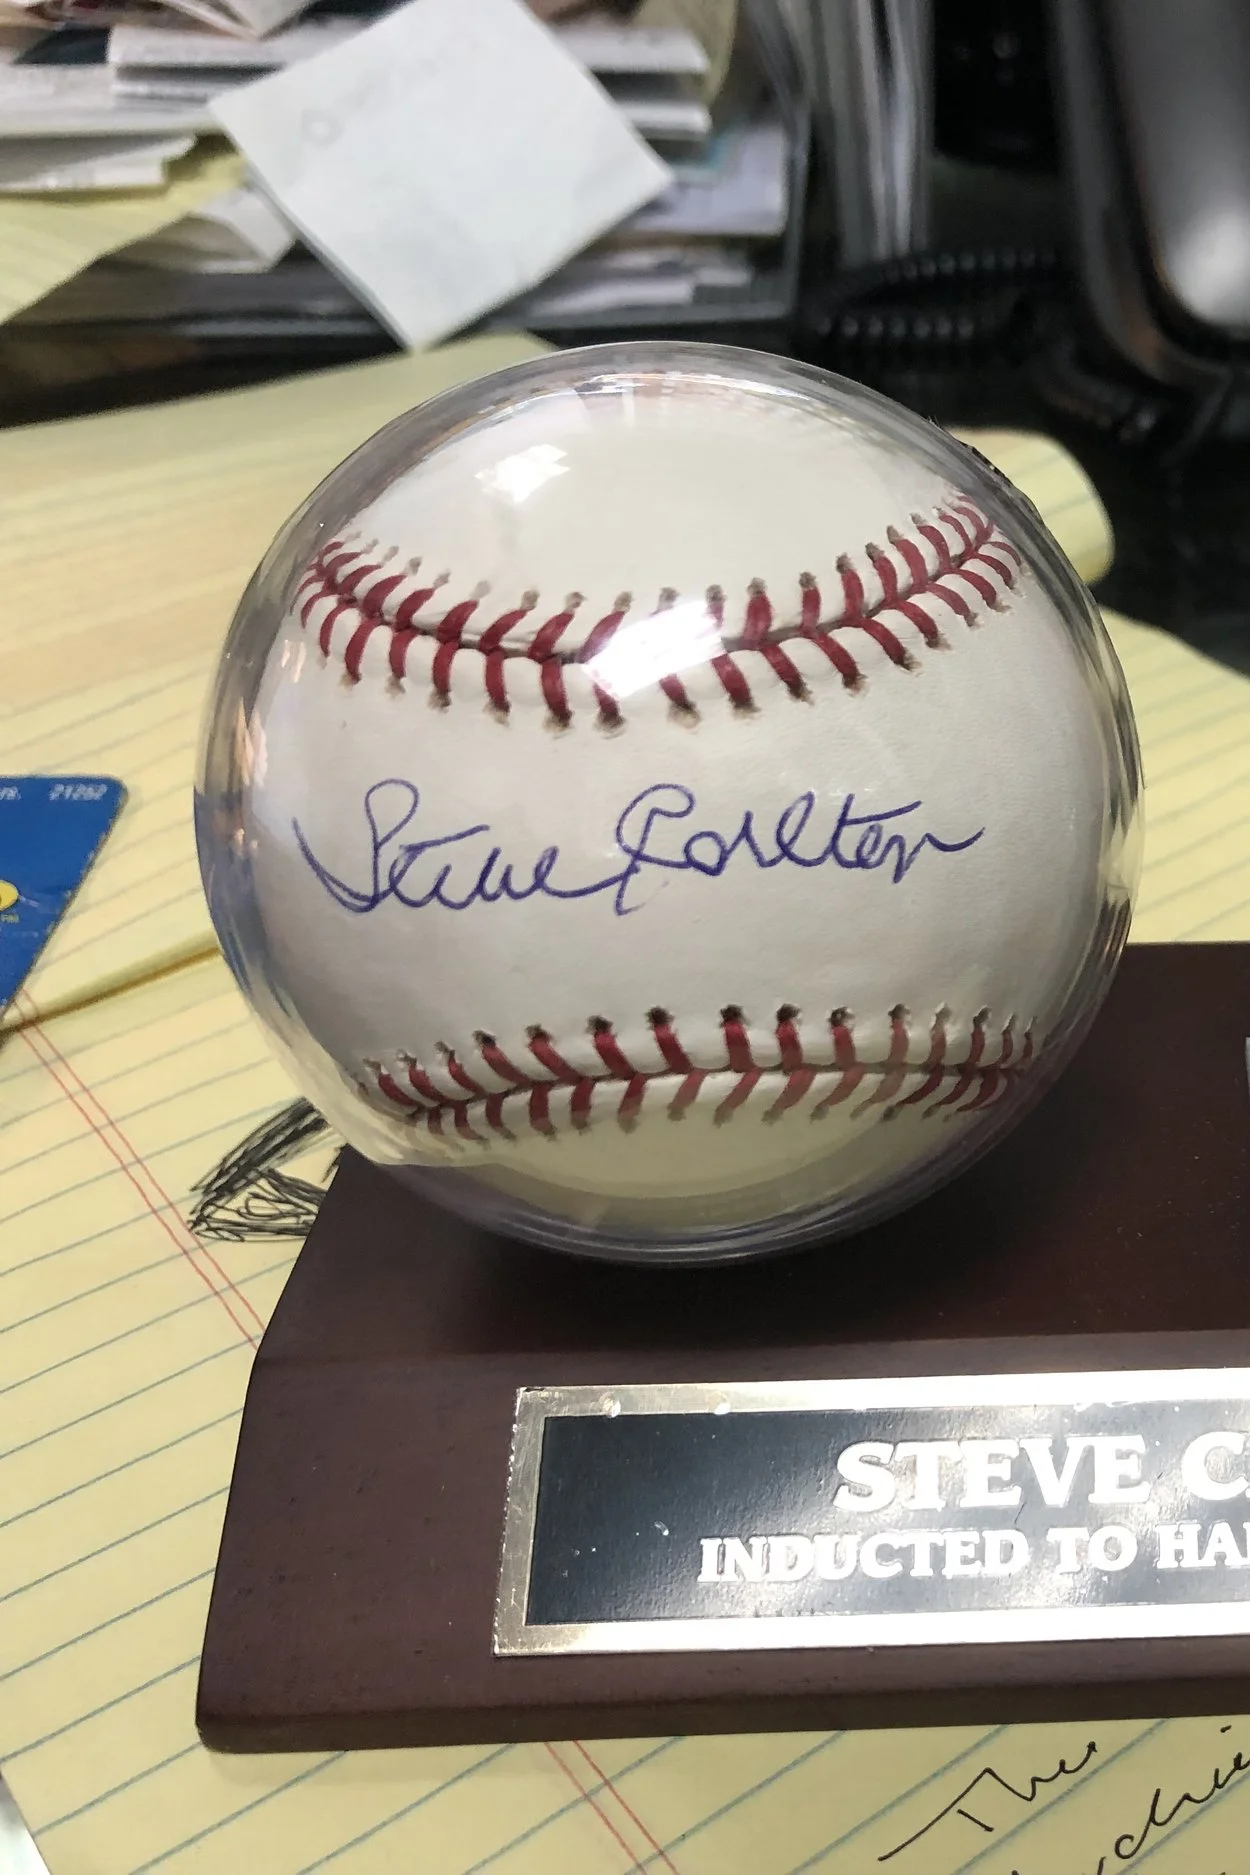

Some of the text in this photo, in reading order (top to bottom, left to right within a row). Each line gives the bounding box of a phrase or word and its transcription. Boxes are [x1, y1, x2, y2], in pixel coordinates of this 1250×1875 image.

[833, 1433, 1152, 1514] STEVE
[697, 1527, 1033, 1584] INDUCTED
[1047, 1522, 1139, 1575] TO
